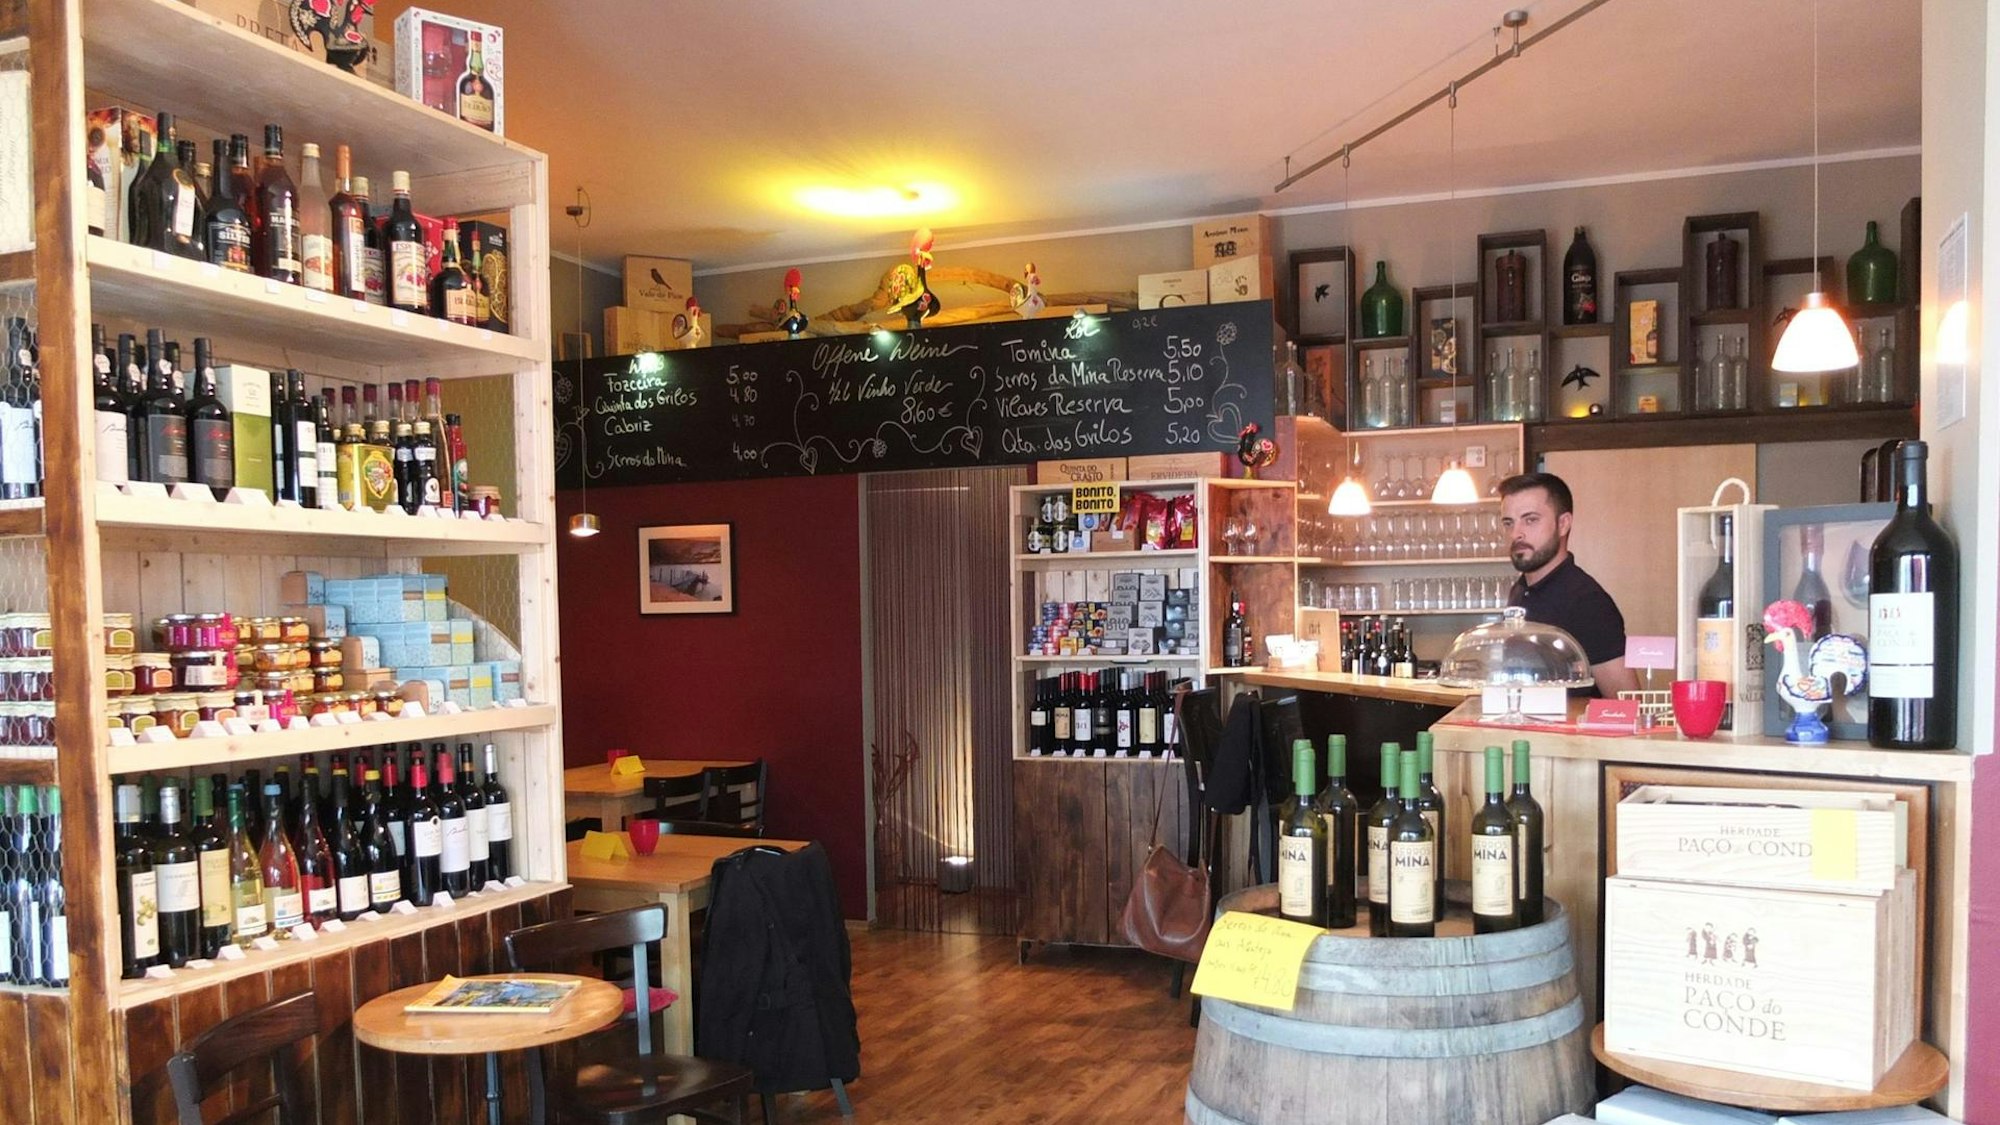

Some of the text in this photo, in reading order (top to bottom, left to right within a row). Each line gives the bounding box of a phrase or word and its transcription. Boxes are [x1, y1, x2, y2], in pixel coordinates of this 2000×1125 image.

[1001, 335, 1202, 363] Tomina 5,50
[1071, 361, 1110, 388] Mina
[1106, 357, 1168, 383] Reserva
[1167, 360, 1204, 385] 5,10
[858, 373, 896, 402] Vinho
[904, 369, 953, 396] Verde
[1049, 392, 1133, 416] Reserva
[1163, 387, 1204, 415] 5,00
[604, 415, 653, 437] Cabriz
[1044, 426, 1072, 452] dos
[1074, 418, 1133, 448] Grilos
[1165, 422, 1200, 445] 5,20
[1075, 498, 1114, 510] BONITO
[1719, 825, 1781, 838] HERDADE
[1473, 849, 1508, 861] MINA
[1678, 837, 1732, 857] PAÇO
[1748, 840, 1813, 858] COND
[1394, 857, 1431, 867] MINA
[1684, 971, 1753, 991] HERDADE
[1684, 985, 1783, 1017] PAÇO do
[1683, 1008, 1787, 1042] CONDE
